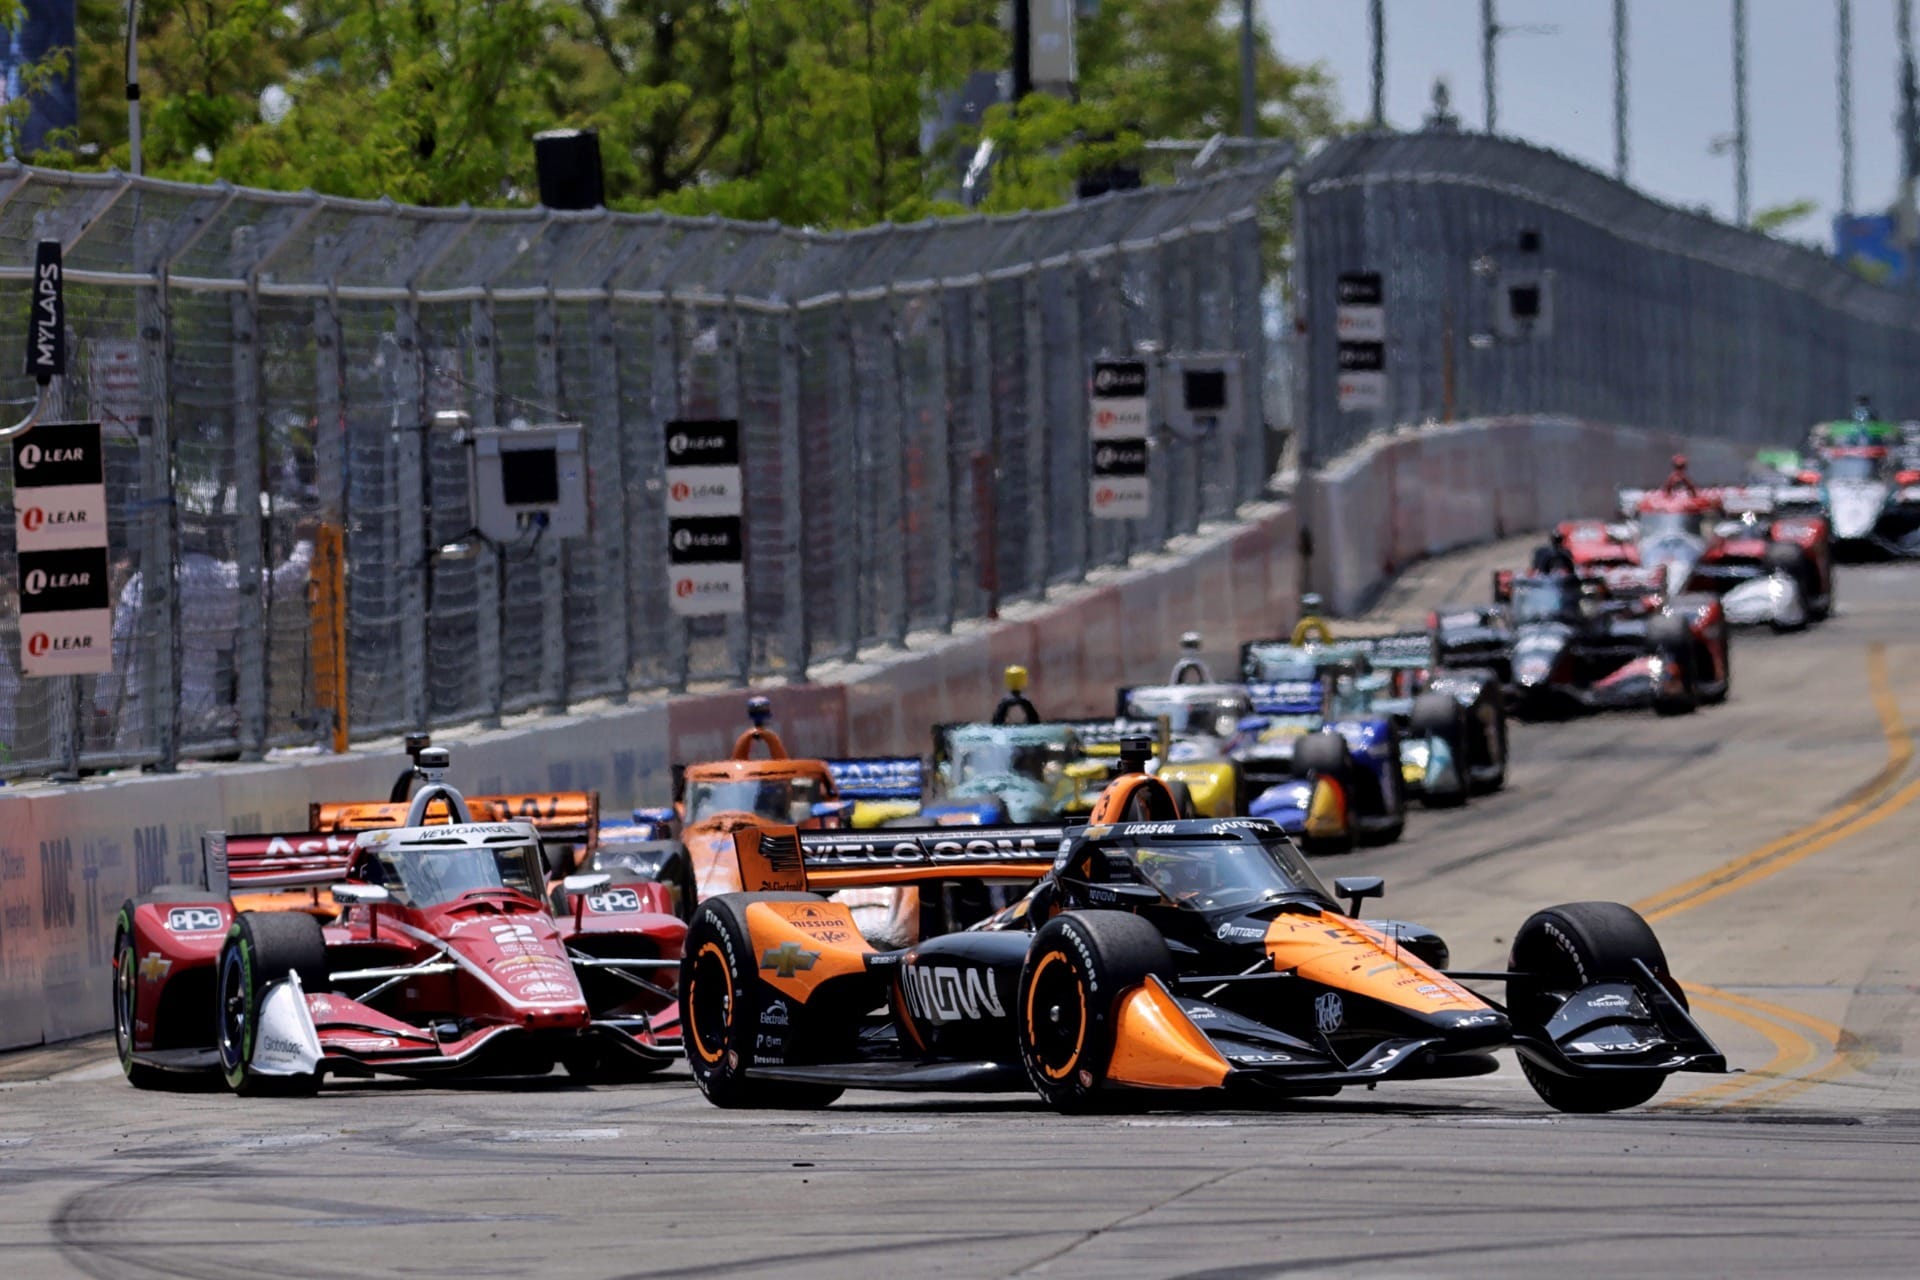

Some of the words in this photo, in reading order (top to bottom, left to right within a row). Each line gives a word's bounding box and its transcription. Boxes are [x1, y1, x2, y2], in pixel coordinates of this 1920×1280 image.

[36, 263, 58, 367] MYLAPS
[44, 447, 84, 462] LEAR
[48, 509, 87, 524] LEAR
[50, 571, 91, 588] LEAR
[52, 635, 93, 650] LEAR
[1123, 825, 1157, 835] LUCAS
[1157, 823, 1176, 834] OIL
[590, 892, 638, 912] PPG
[172, 910, 220, 930] PPG
[489, 924, 538, 944] 2
[705, 909, 738, 979] Firestone
[1061, 923, 1099, 993] Firestone
[1544, 922, 1588, 985] Firestone
